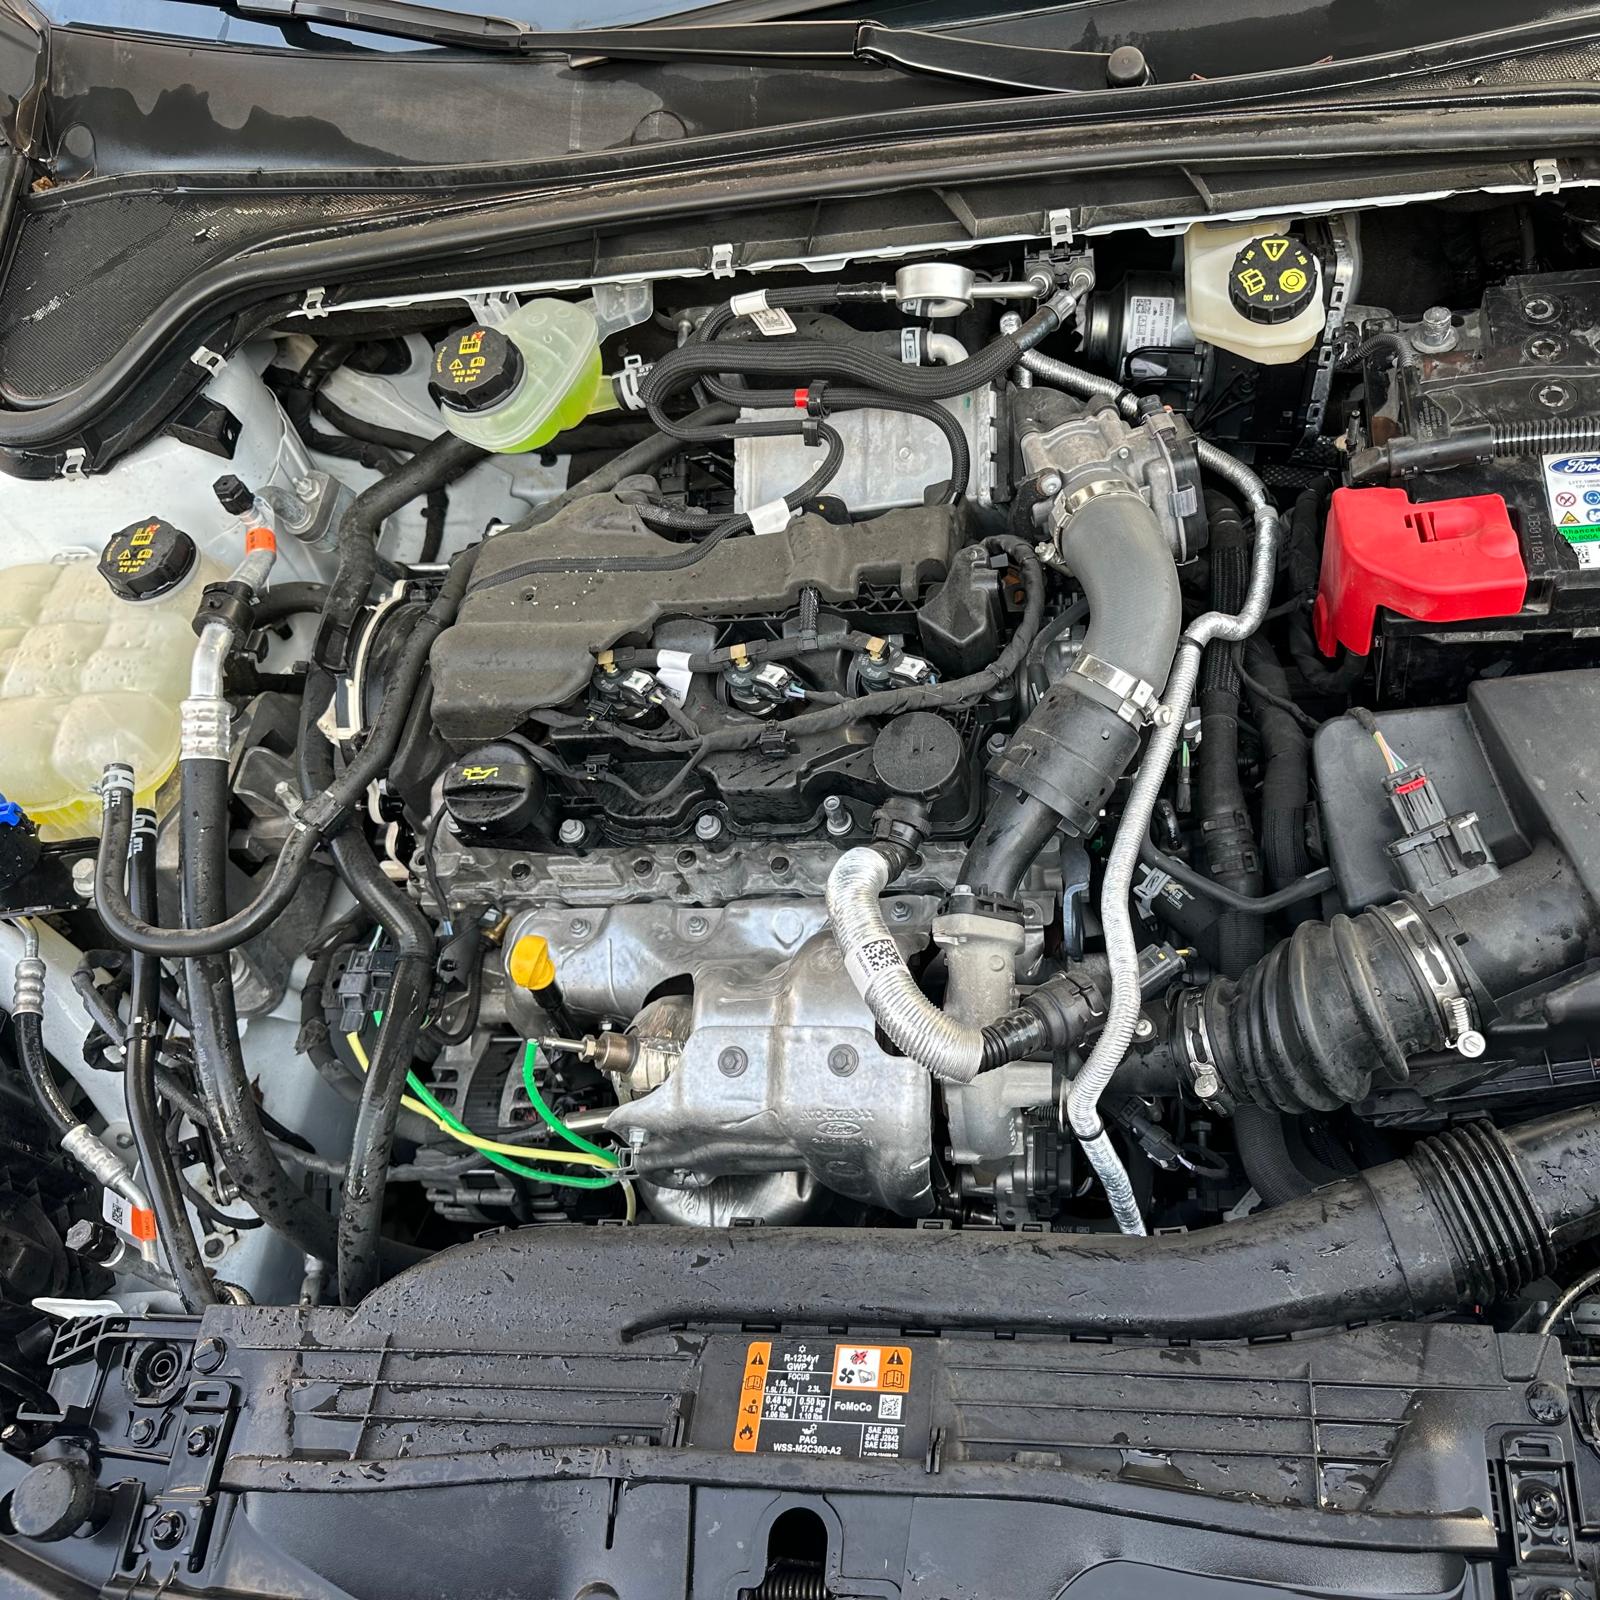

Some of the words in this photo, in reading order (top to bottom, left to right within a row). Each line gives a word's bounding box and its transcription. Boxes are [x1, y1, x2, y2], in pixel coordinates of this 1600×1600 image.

[784, 1353, 820, 1364] R-1234yf
[786, 1362, 807, 1371] GWP
[808, 1362, 814, 1371] 4
[787, 1372, 810, 1381] FOCUS
[783, 1396, 792, 1407] kg
[799, 1397, 815, 1406] 0.50
[816, 1398, 827, 1409] kg
[834, 1401, 872, 1412] FoMoCo
[779, 1411, 789, 1419] lbs
[798, 1412, 812, 1420] 1.10
[812, 1413, 823, 1421] lbs
[867, 1426, 882, 1434] SAE
[798, 1436, 818, 1445] PAG
[865, 1433, 879, 1441] SAE
[773, 1443, 842, 1455] WSS-M2C300-A2
[864, 1440, 879, 1449] SAE
